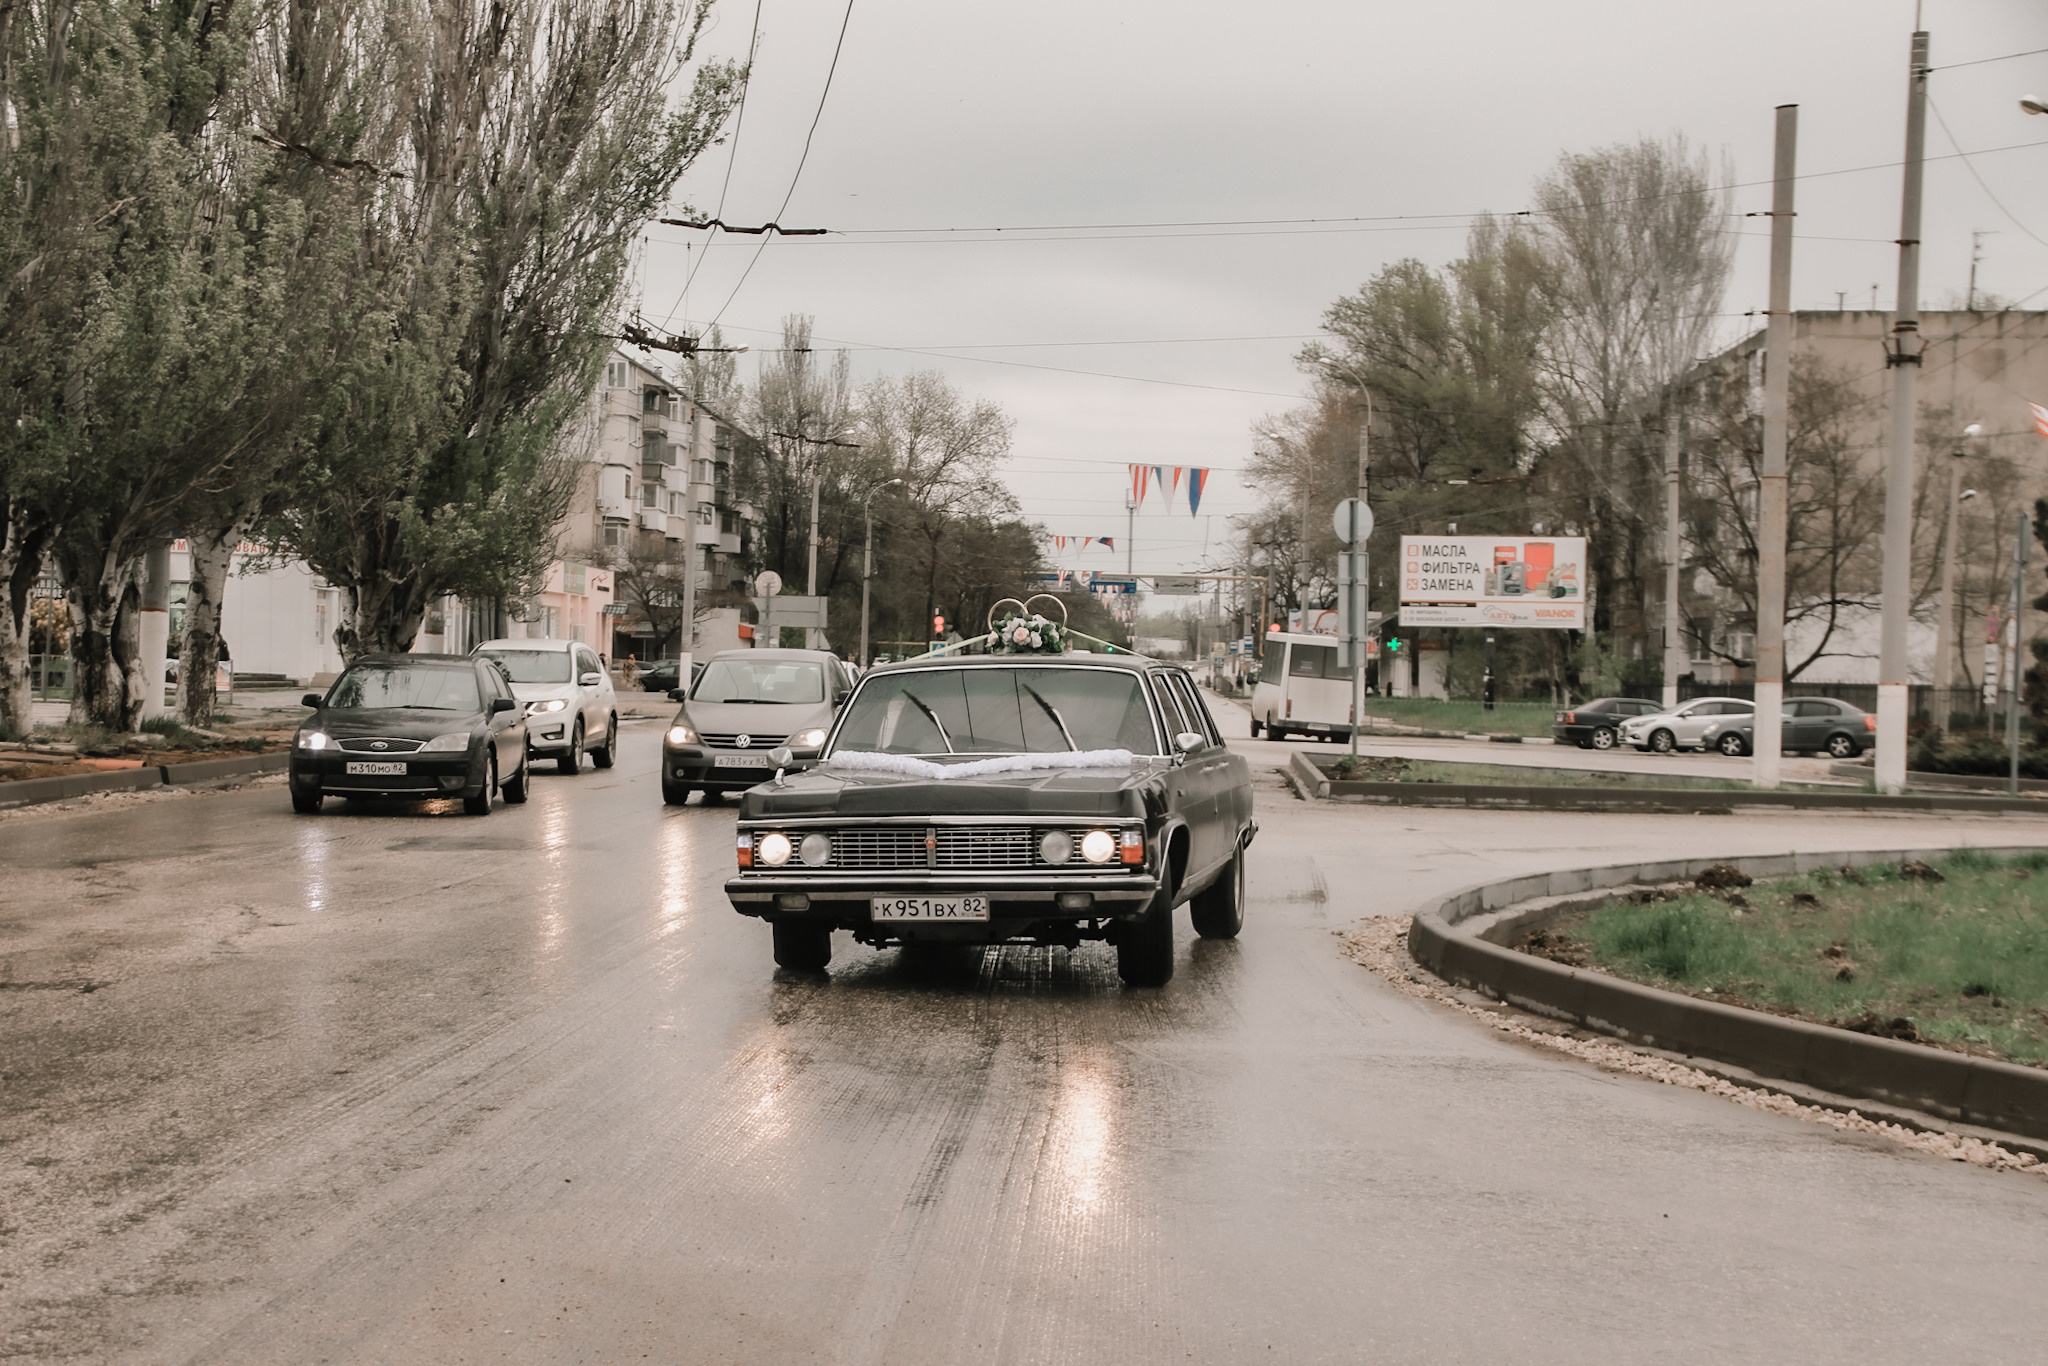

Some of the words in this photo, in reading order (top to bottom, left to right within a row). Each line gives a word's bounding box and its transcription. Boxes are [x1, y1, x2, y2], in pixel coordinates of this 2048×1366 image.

[1422, 545, 1467, 557] МАСЛА
[1422, 561, 1481, 574] ФИЛЬТРА
[1421, 578, 1474, 591] ЗАМЕНА
